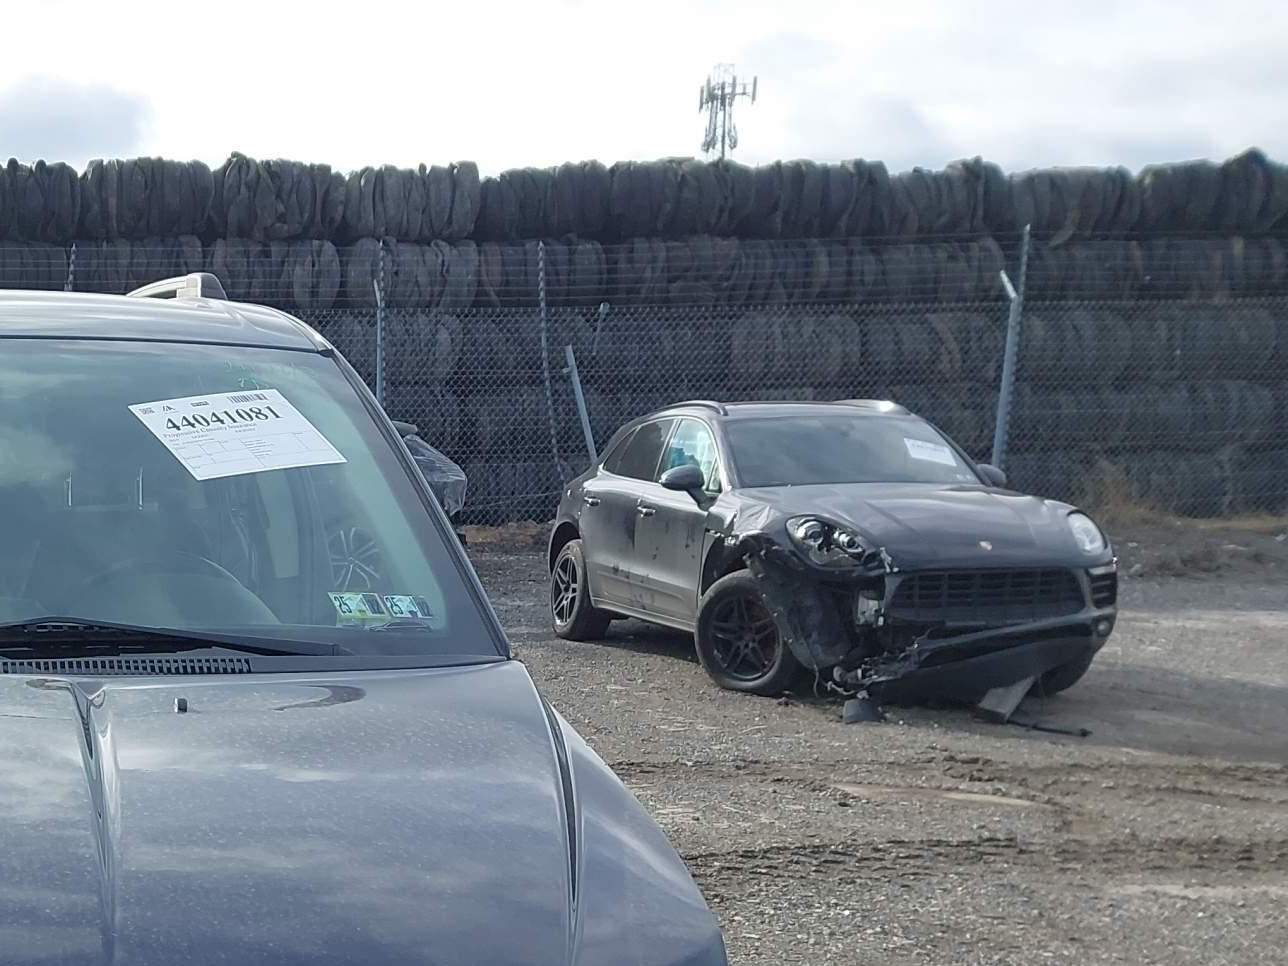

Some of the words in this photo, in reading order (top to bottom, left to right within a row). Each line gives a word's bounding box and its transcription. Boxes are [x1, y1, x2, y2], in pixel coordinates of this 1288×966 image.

[166, 405, 284, 431] 44041081
[333, 595, 352, 614] 25
[385, 596, 404, 615] 25
